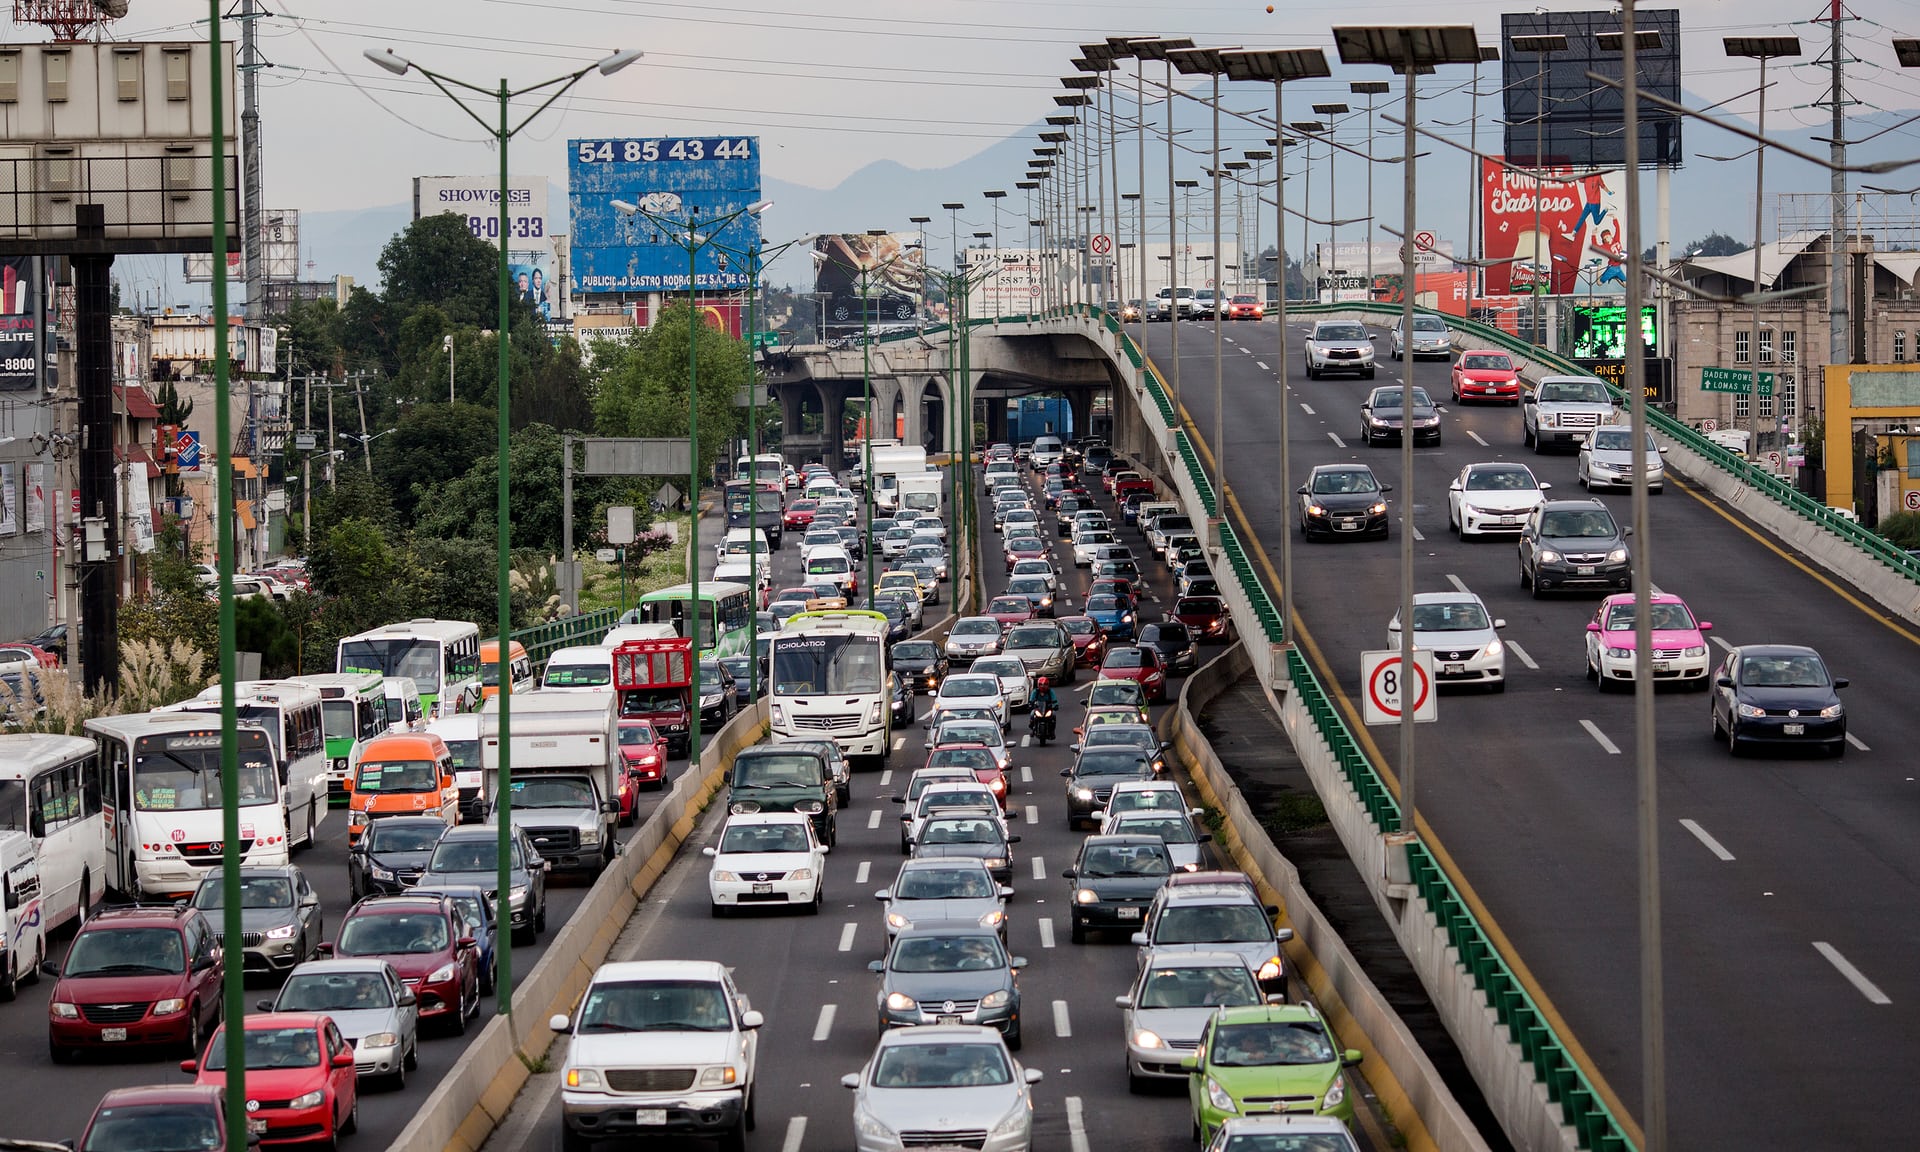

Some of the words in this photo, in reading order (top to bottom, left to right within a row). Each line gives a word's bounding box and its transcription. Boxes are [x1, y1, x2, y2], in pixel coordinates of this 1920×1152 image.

[579, 141, 615, 163] 54
[623, 141, 660, 162] 85
[668, 139, 705, 161] 43
[713, 138, 751, 160] 44
[1491, 190, 1575, 215] Sabroso
[629, 275, 661, 287] CASTRO
[725, 273, 738, 285] DE
[1703, 370, 1729, 379] BADEN
[1713, 382, 1739, 391] LOMAS
[1741, 384, 1771, 393] VEDES
[777, 640, 826, 650] SCHOLASTICO
